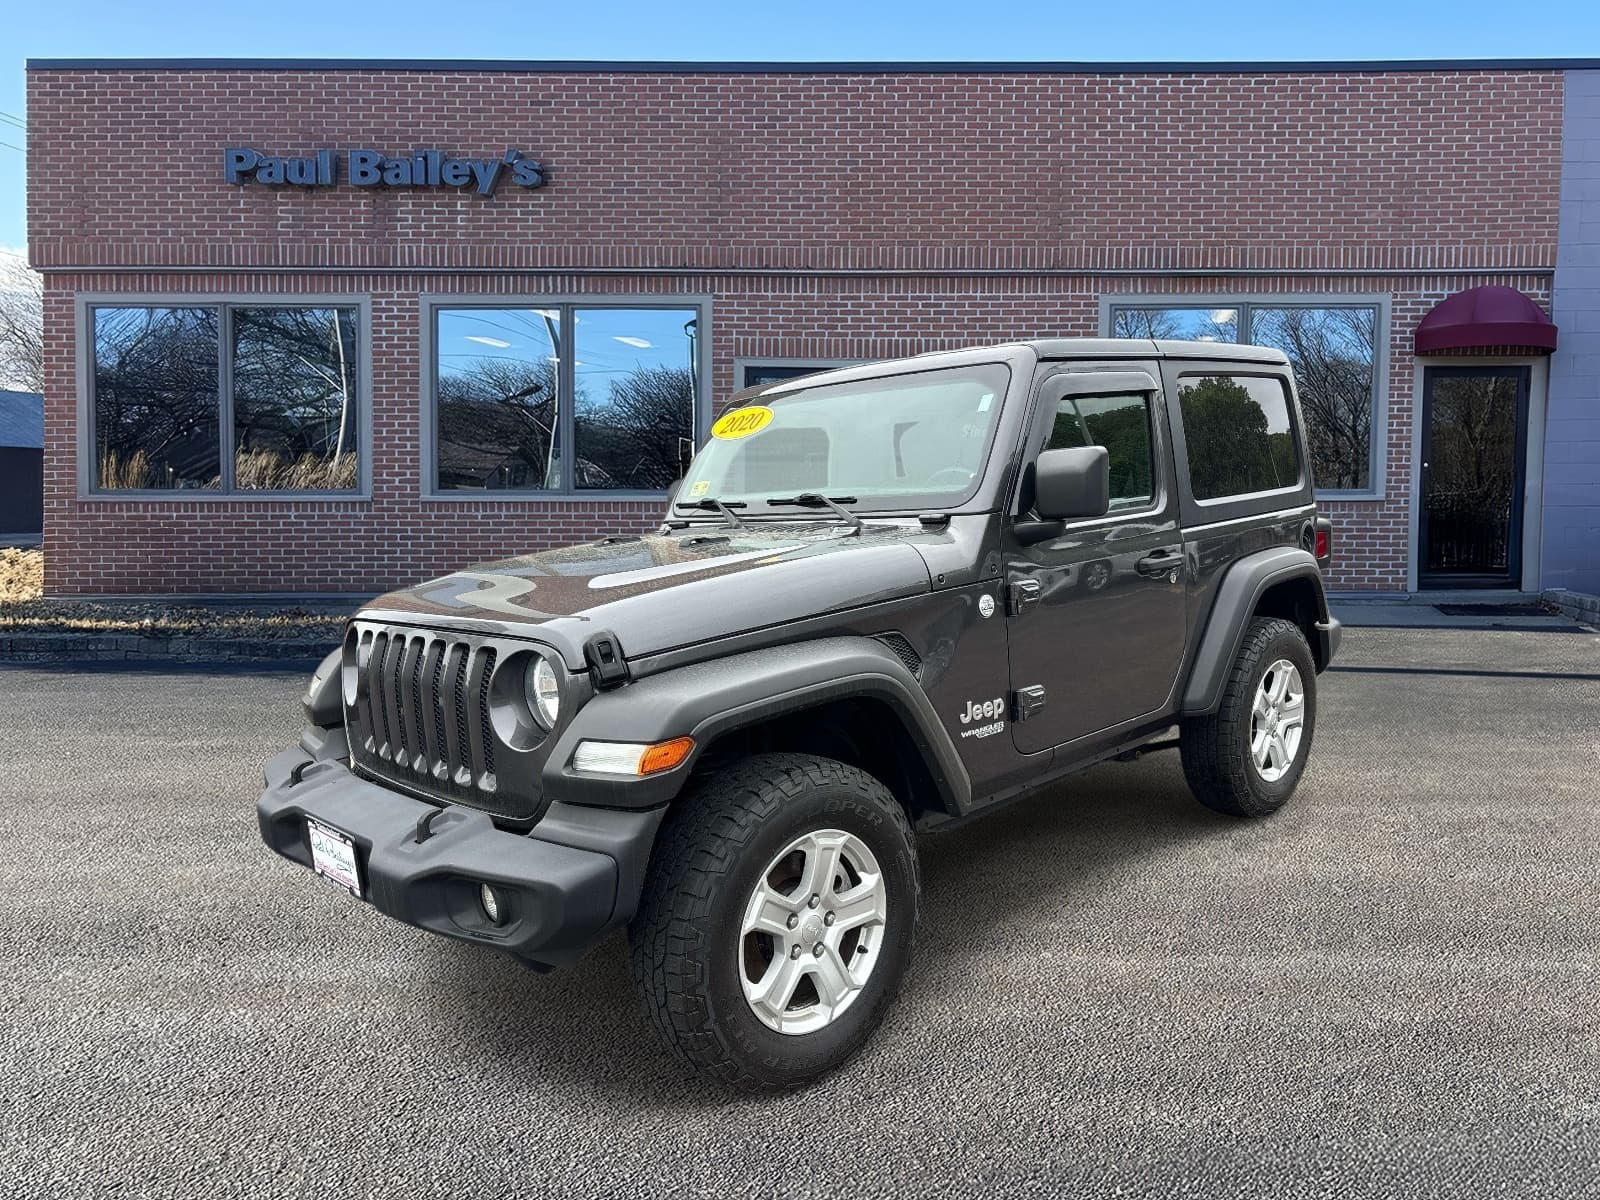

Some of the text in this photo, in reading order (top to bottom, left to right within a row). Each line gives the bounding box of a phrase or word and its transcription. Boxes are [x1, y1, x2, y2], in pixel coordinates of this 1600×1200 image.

[224, 147, 546, 197] Paul Bailey's
[718, 411, 766, 435] 2020
[959, 697, 1005, 724] Jeep
